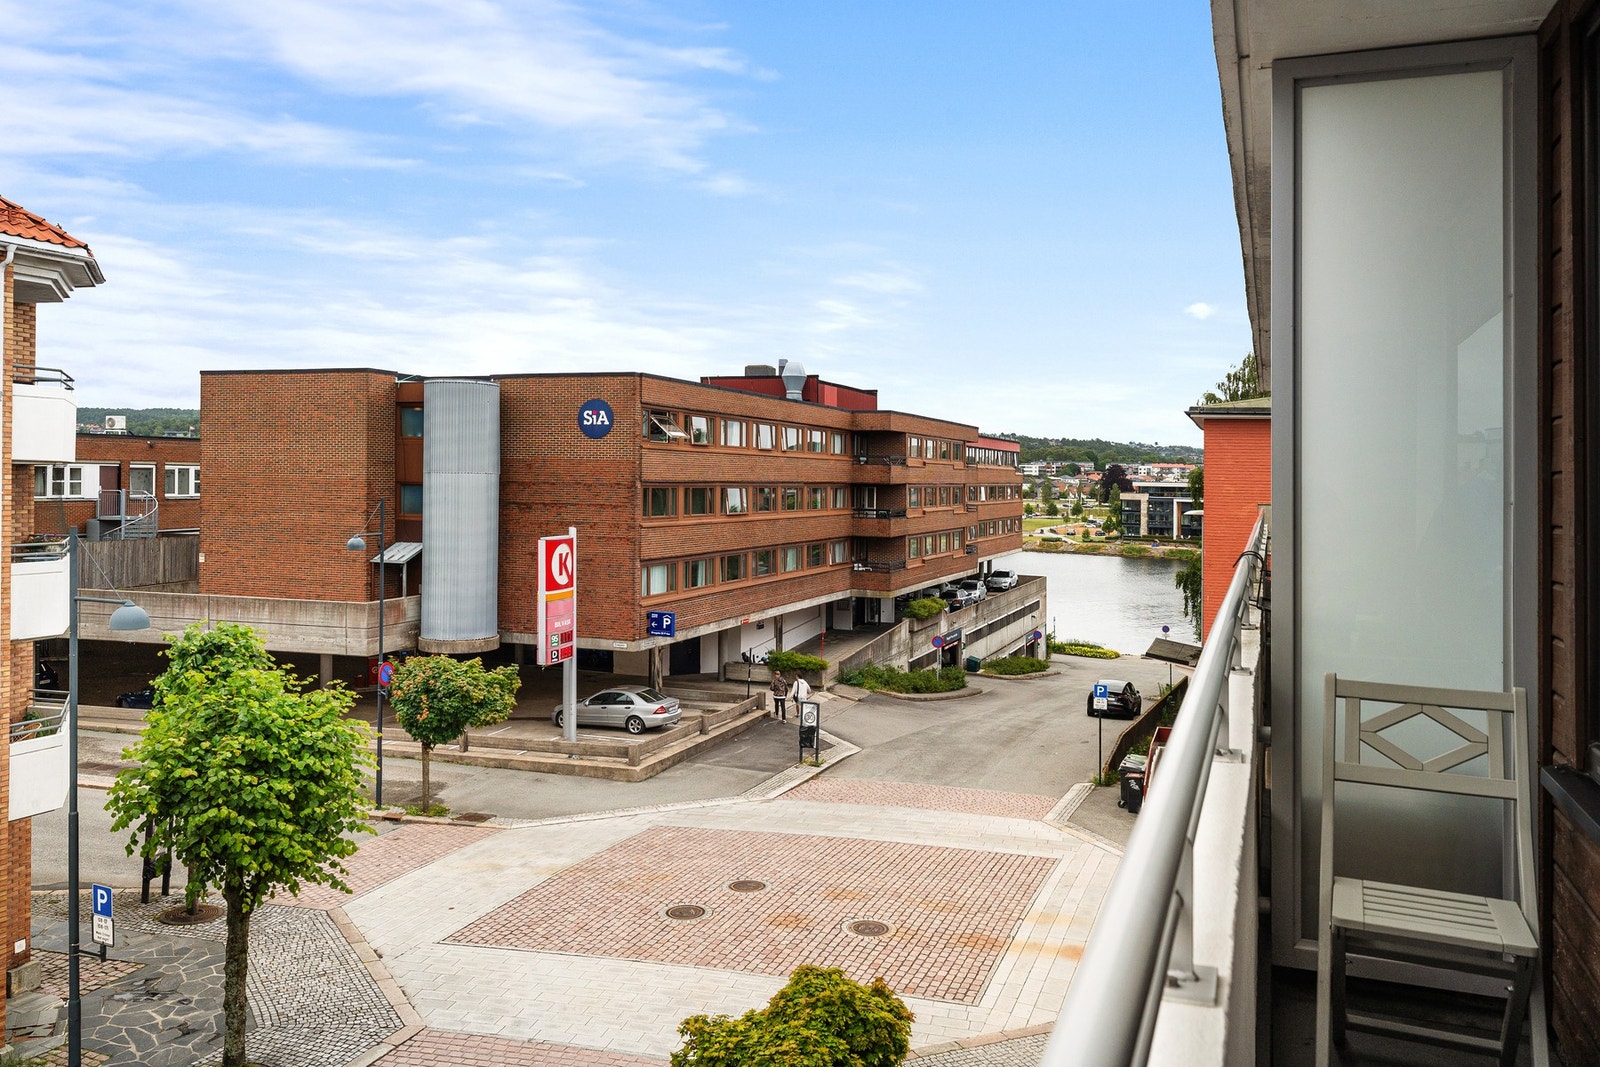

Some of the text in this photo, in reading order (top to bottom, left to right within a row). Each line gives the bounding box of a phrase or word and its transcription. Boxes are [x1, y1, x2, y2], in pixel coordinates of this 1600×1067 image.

[583, 409, 610, 425] SiA
[558, 551, 571, 581] K
[663, 618, 671, 629] P
[551, 634, 559, 643] 95
[552, 650, 558, 658] D
[1096, 686, 1105, 697] P
[97, 888, 108, 912] P
